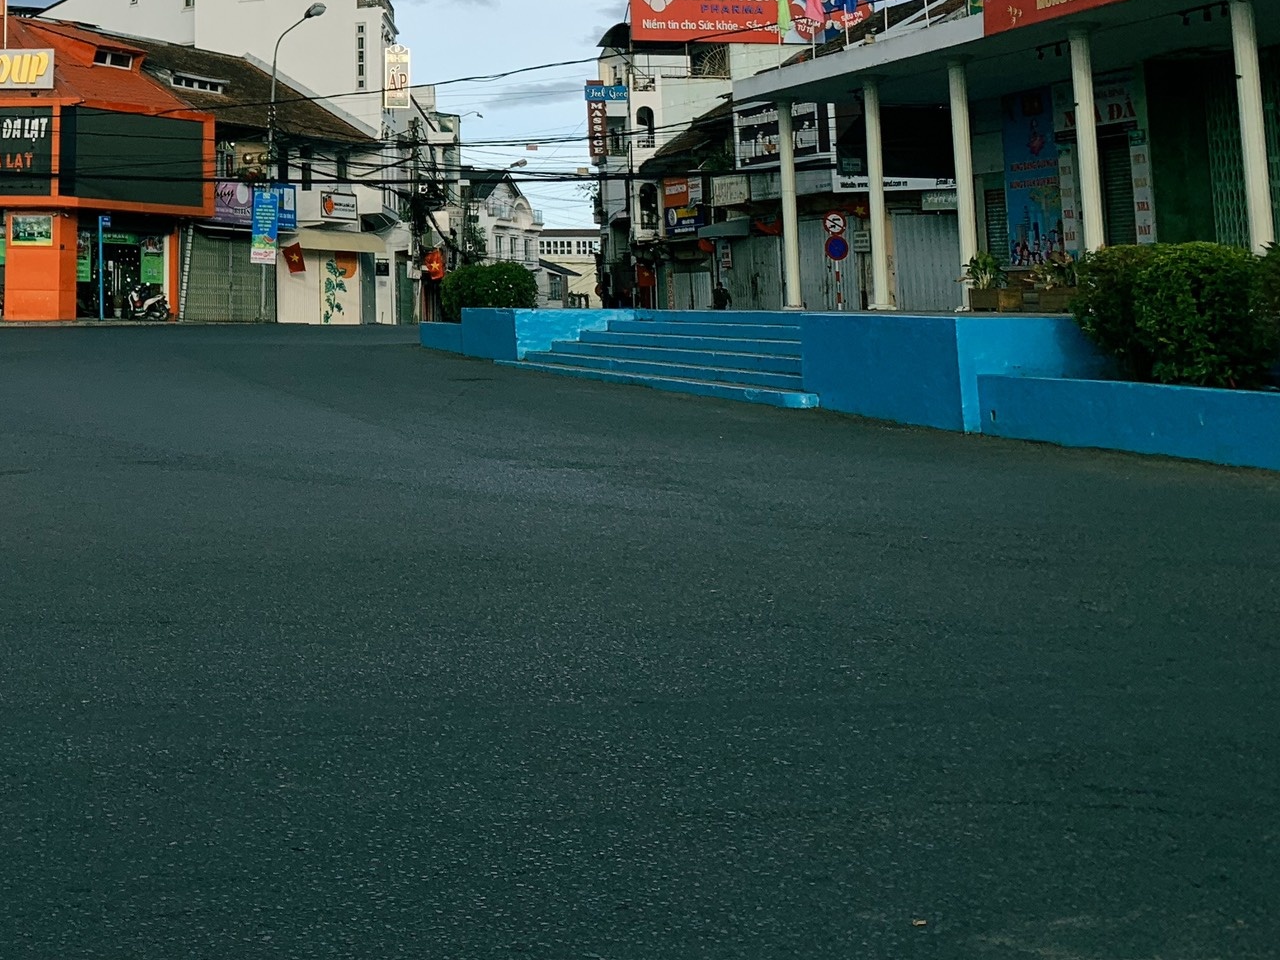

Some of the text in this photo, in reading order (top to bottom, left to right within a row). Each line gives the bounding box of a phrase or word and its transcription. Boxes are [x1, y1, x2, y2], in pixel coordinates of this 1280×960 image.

[700, 4, 764, 14] PHARMA
[642, 19, 666, 29] Niềm
[668, 19, 679, 29] tin
[681, 20, 696, 30] cho
[697, 19, 715, 30] Sức
[716, 19, 738, 31] khỏe
[587, 87, 605, 98] Feel
[3, 114, 22, 139] ĐÀ
[24, 117, 48, 142] LẠT
[6, 152, 33, 172] LẠT
